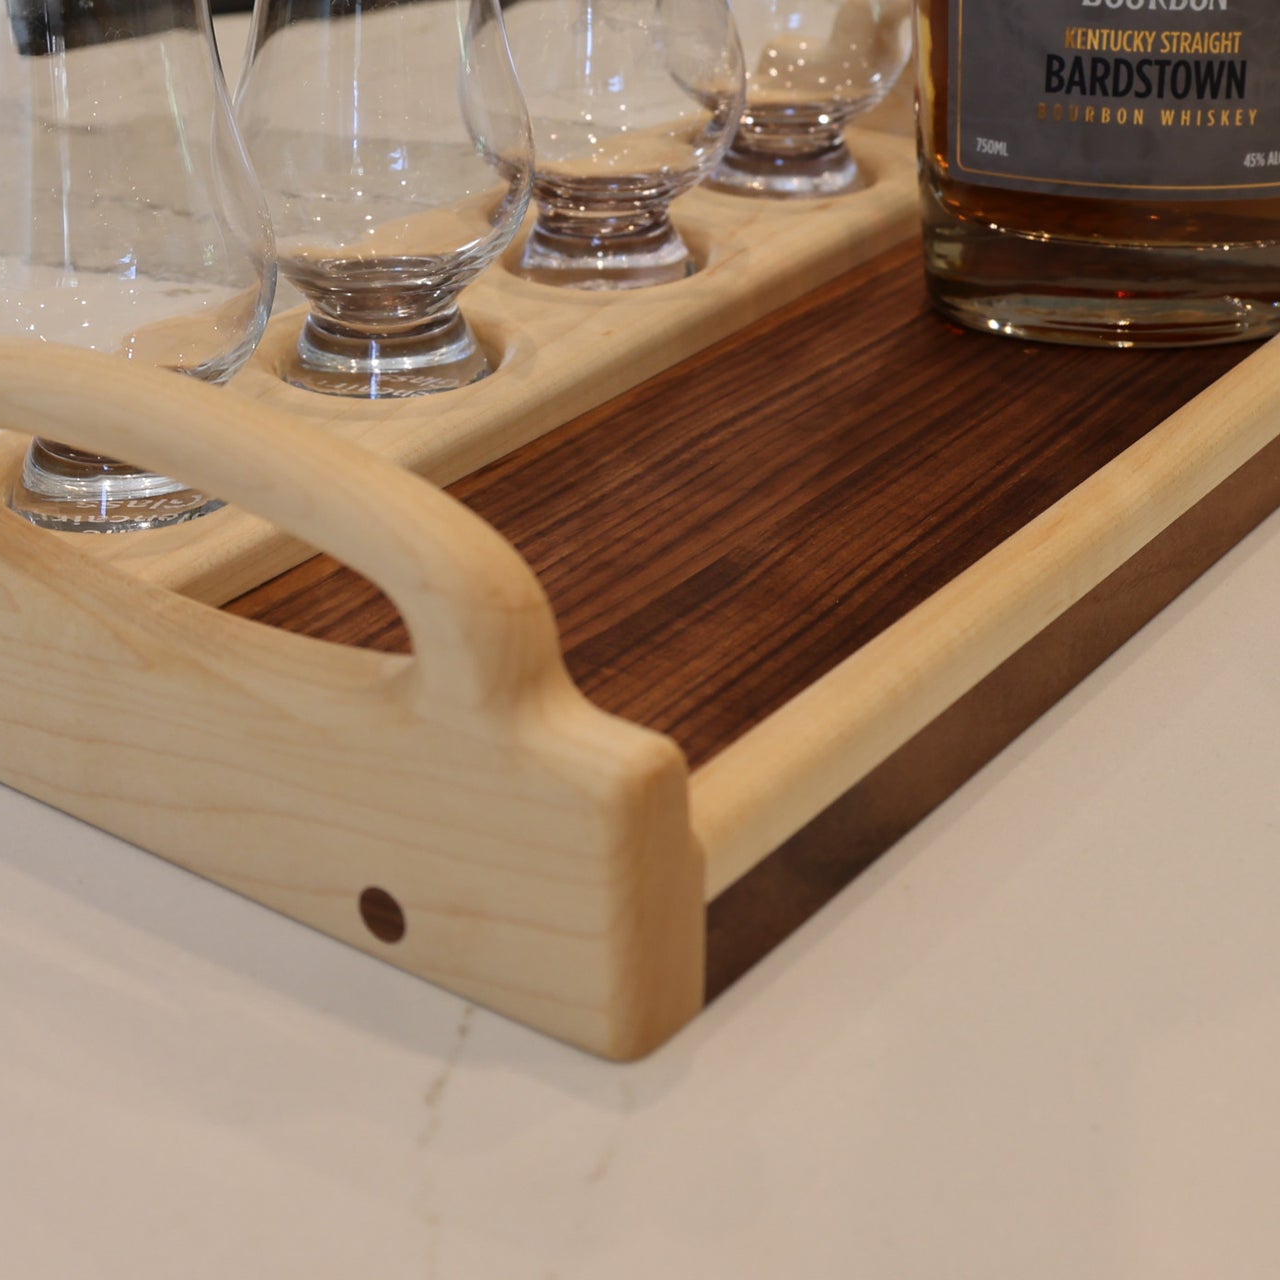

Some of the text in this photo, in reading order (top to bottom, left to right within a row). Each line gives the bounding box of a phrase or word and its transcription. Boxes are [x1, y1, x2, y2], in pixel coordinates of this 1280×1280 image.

[1064, 27, 1243, 54] KENTUCKY STRAIGHT
[1044, 54, 1247, 99] BARDSTOWN
[1037, 102, 1258, 127] BOURBON WHISKEY
[976, 137, 1009, 157] 750ML
[1243, 151, 1265, 168] 45%
